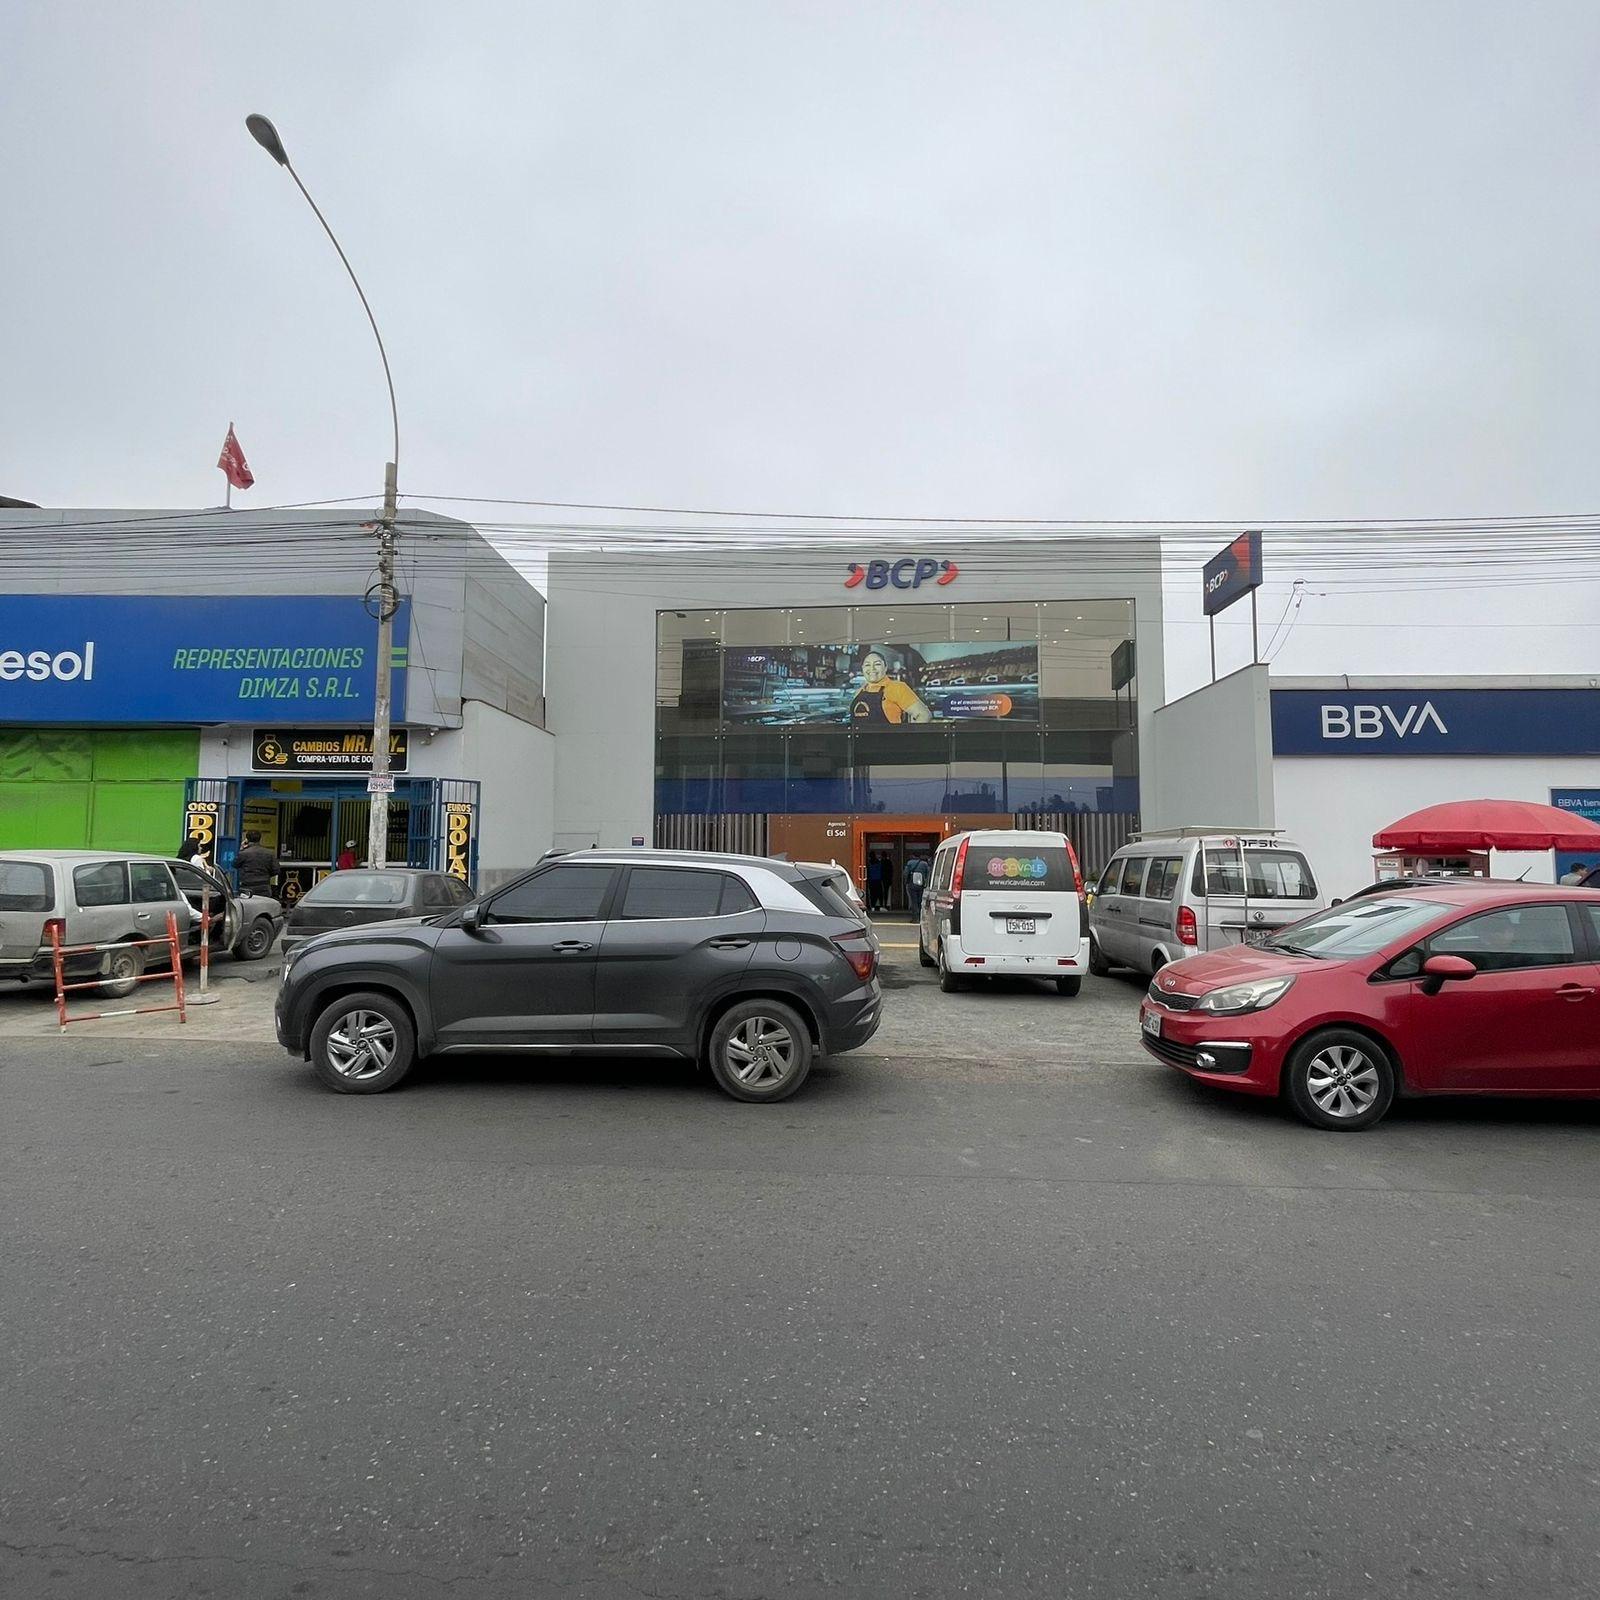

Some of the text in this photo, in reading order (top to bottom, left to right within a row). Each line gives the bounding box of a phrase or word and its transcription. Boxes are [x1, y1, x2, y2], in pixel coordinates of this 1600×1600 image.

[866, 558, 938, 589] BCP
[1209, 571, 1225, 592] BCP
[0, 641, 94, 681] esol
[173, 648, 364, 669] REPRESENTACIONES
[238, 677, 360, 699] DIMZA S.R.L.
[1321, 701, 1448, 738] BBVA
[293, 741, 340, 752] CAMBIOS
[188, 803, 217, 811] ORO
[447, 804, 471, 812] EUROS
[1558, 799, 1582, 807] BBVA
[992, 863, 1043, 873] RICAVALE
